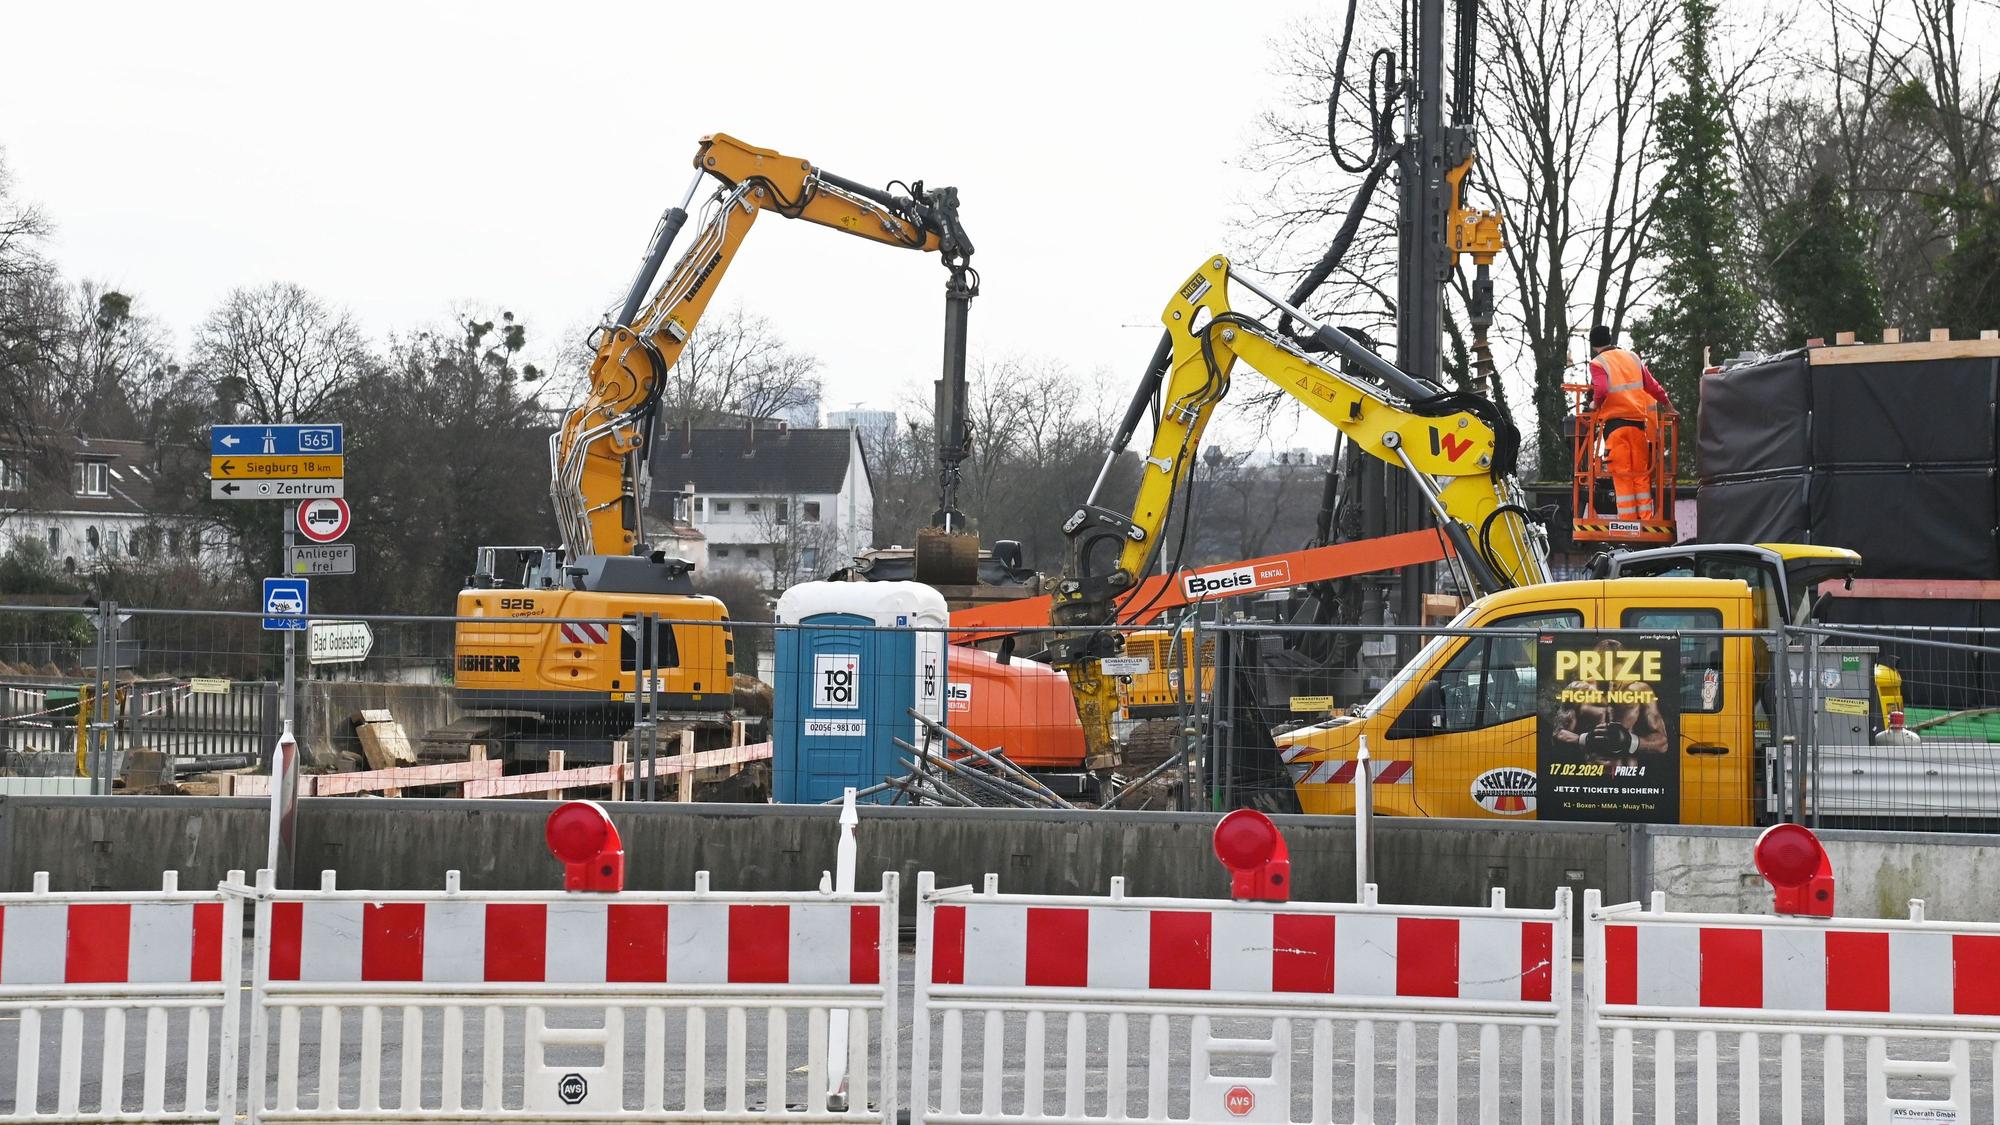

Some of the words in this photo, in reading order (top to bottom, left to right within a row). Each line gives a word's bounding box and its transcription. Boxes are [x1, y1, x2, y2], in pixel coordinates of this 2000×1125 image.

[1181, 274, 1205, 299] MIETE
[304, 434, 328, 447] 565
[247, 462, 298, 475] Siegburg
[303, 462, 315, 472] 18
[317, 464, 331, 472] km
[276, 482, 335, 495] Zentrum
[297, 549, 348, 560] Anlieger
[312, 562, 333, 572] frei
[1189, 572, 1252, 594] Boels
[1260, 568, 1283, 579] RENTAL
[500, 599, 534, 610] 926
[511, 608, 545, 618] compact
[314, 633, 327, 652] Bad
[329, 629, 365, 653] Godesberg
[1556, 650, 1661, 681] PRIZE
[824, 670, 853, 686] TOI
[924, 664, 936, 681] TOI
[823, 686, 852, 702] TOI
[924, 680, 936, 697] TOI
[1555, 689, 1604, 704] -FIGHT
[1607, 689, 1659, 704] NIGHT-
[810, 723, 832, 732] 02056
[836, 723, 850, 732] 981
[851, 723, 861, 732] 00
[1549, 764, 1604, 777] 17.02.2024
[1614, 766, 1638, 777] PRIZE
[1639, 766, 1646, 777] 4
[1480, 771, 1537, 789] FEICKERT
[1582, 786, 1620, 794] TICKETS
[1621, 787, 1660, 795] SICHERN
[1622, 803, 1640, 811] Muay
[564, 1084, 582, 1094] AVS
[1230, 1097, 1249, 1106] AVS
[1908, 1109, 1935, 1117] Overath
